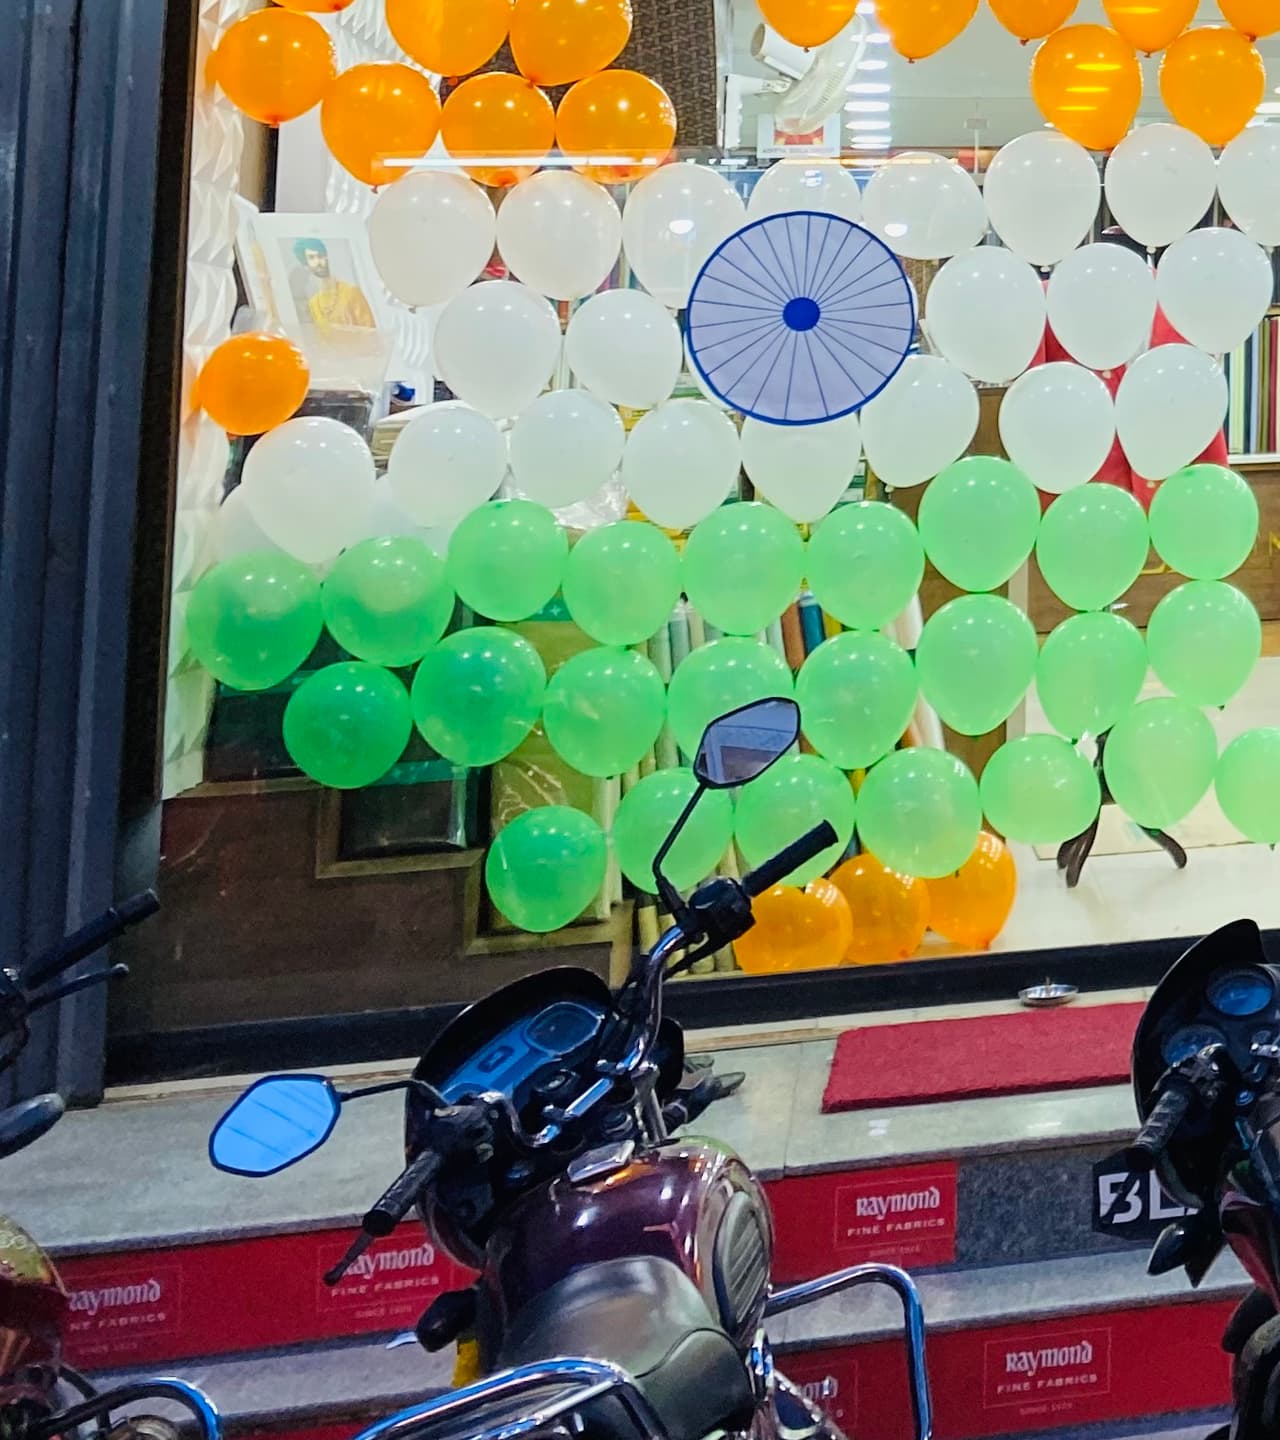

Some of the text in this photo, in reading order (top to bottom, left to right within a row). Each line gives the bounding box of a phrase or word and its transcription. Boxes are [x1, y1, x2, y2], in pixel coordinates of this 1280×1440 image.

[856, 1185, 941, 1221] Raymond
[342, 1242, 435, 1280] aymond
[1005, 1339, 1093, 1377] Raymond
